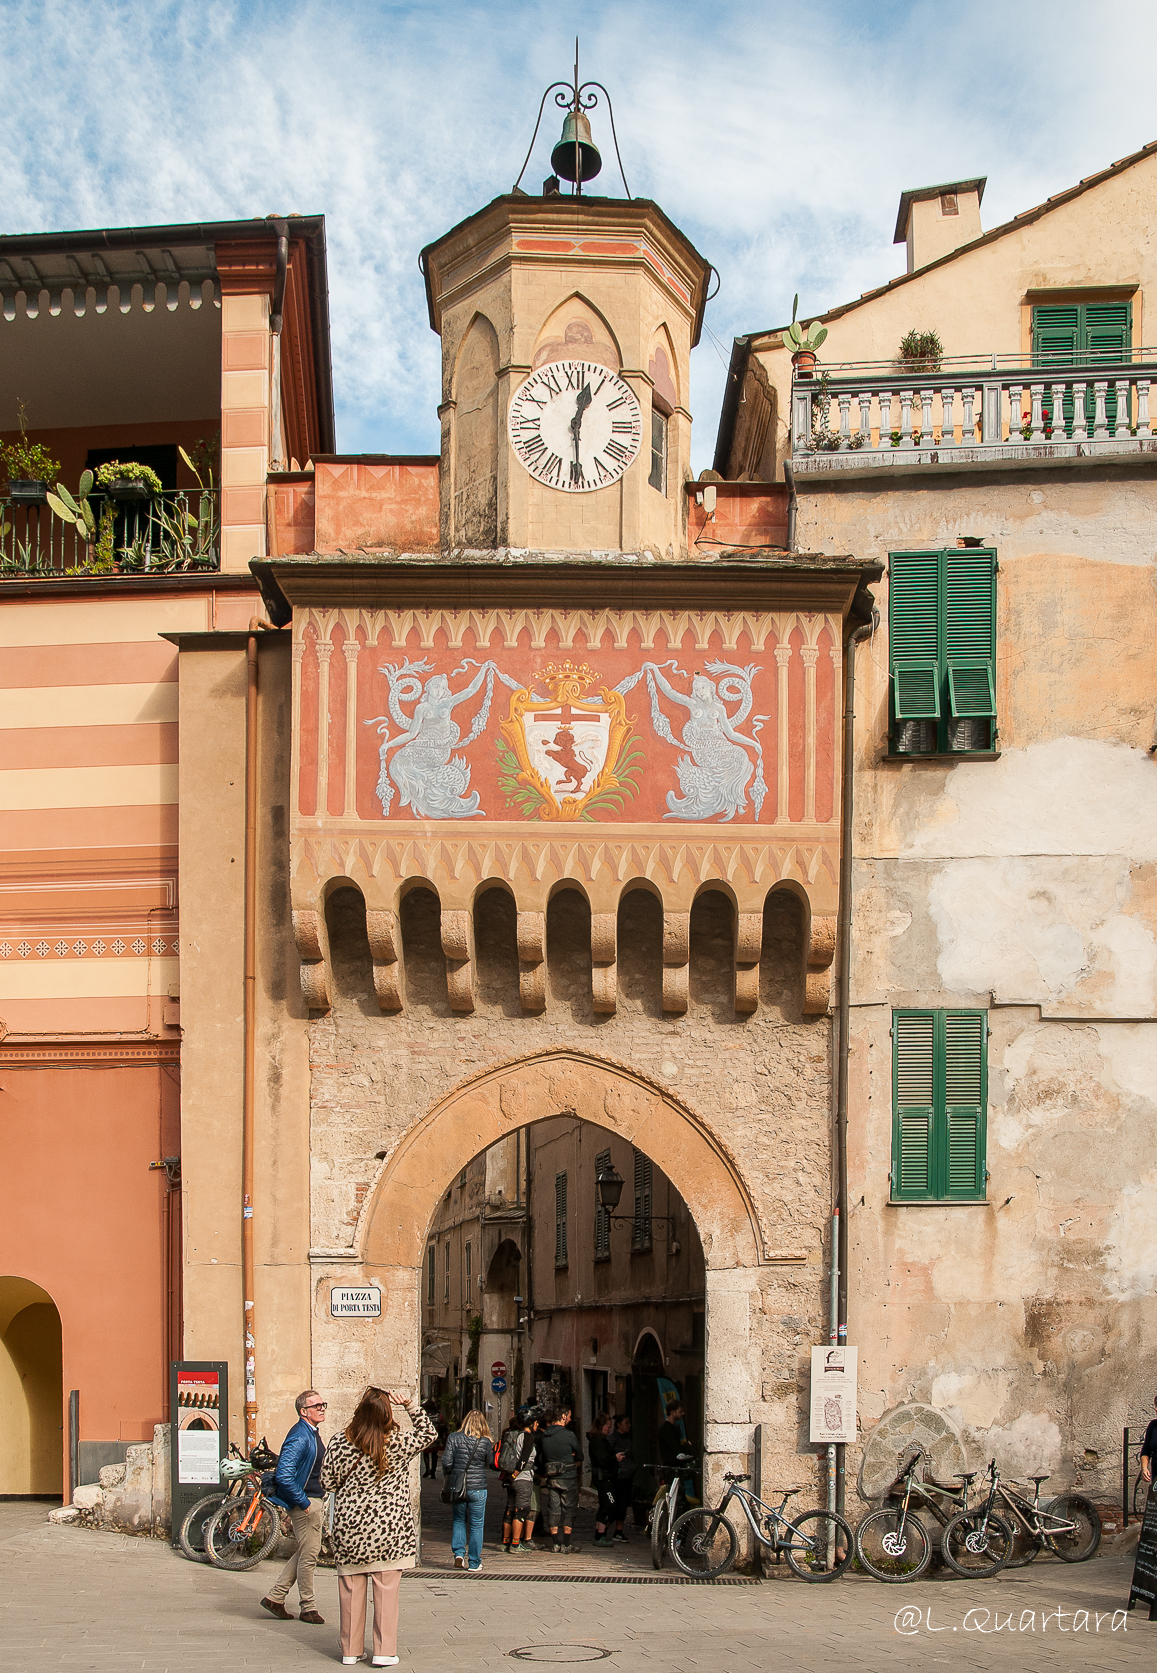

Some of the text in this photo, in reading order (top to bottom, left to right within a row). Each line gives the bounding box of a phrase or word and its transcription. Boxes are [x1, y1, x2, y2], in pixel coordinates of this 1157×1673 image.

[540, 374, 562, 400] XI
[564, 370, 586, 391] XII
[524, 393, 548, 411] X
[605, 396, 627, 412] II
[519, 414, 541, 431] IX
[611, 421, 633, 434] III
[593, 456, 610, 478] V
[341, 1292, 372, 1301] PIAZZA
[332, 1303, 380, 1312] DI PORTA TESTA
